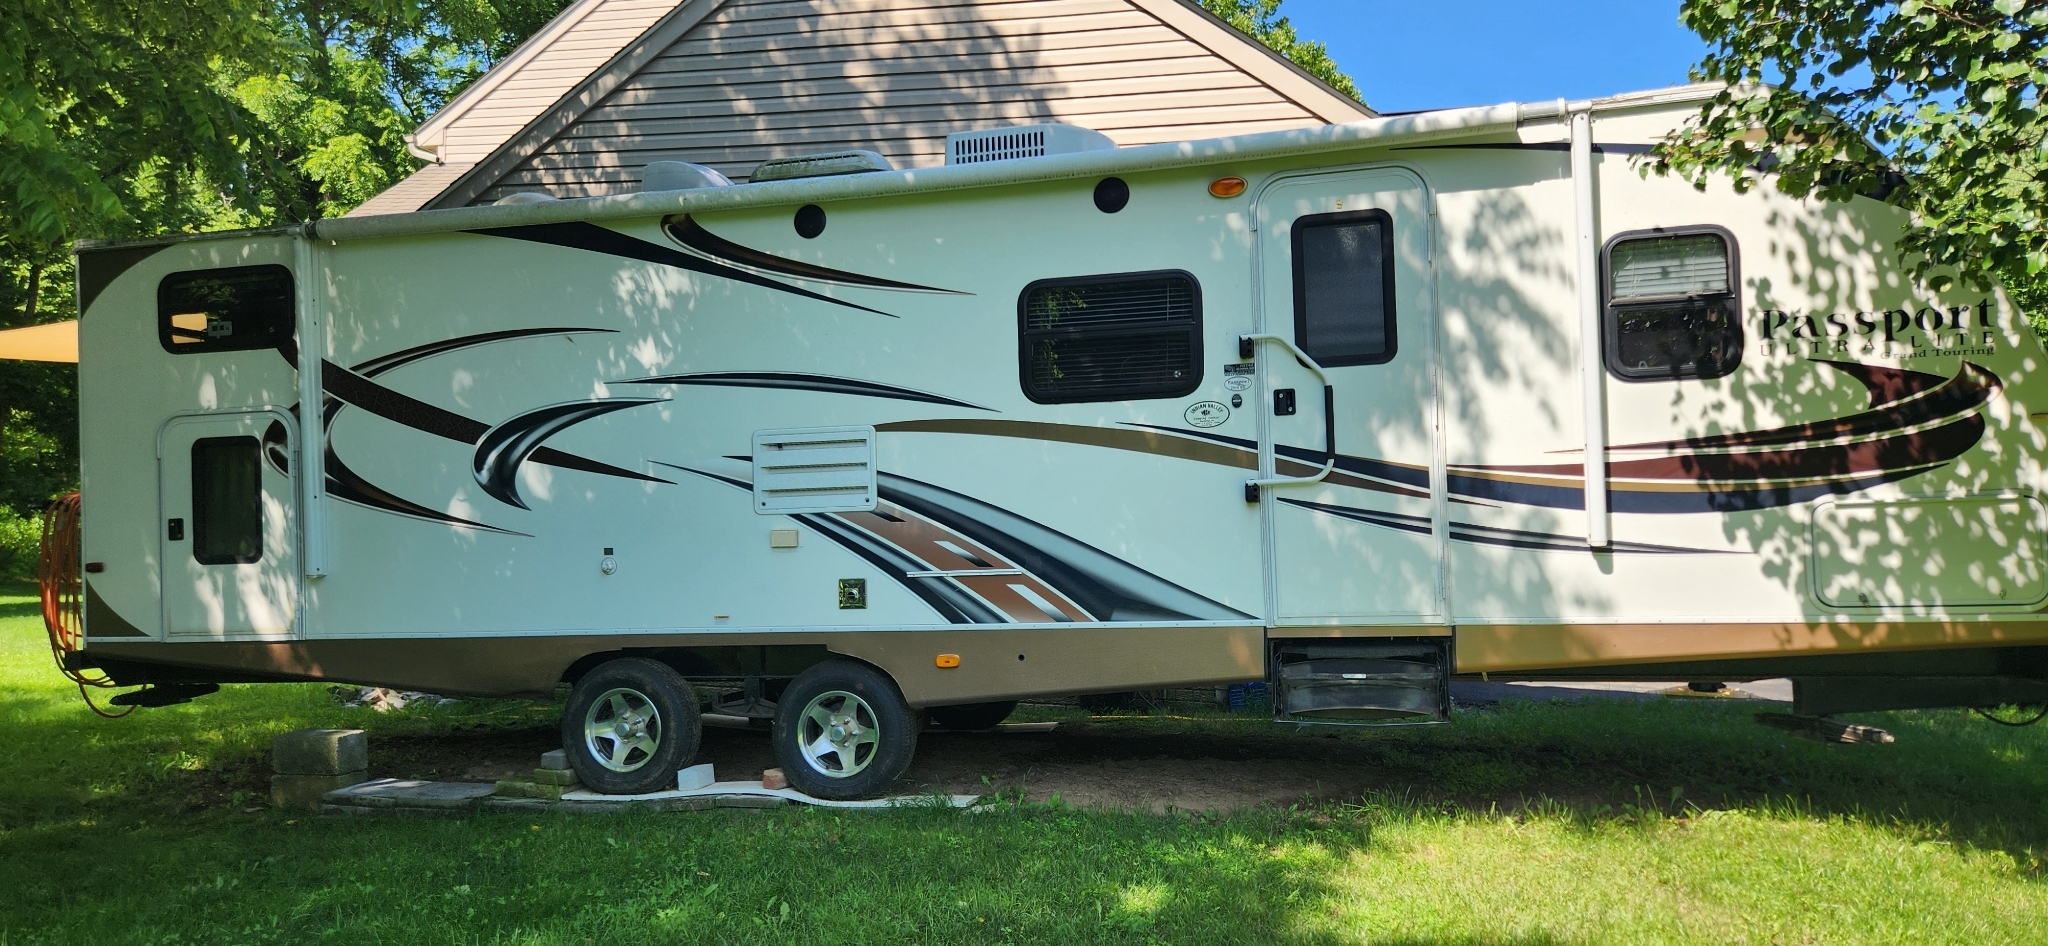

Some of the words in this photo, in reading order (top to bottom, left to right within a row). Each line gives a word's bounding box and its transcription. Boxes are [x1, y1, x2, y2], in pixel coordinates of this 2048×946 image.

[1759, 298, 1995, 342] Passport
[1760, 338, 1876, 357] ULTRA
[1910, 331, 1995, 348] LITE
[1880, 349, 1927, 360] Grand
[1931, 346, 1995, 358] Touring
[1190, 403, 1207, 414] INDIAN
[1207, 403, 1224, 413] VALLEY
